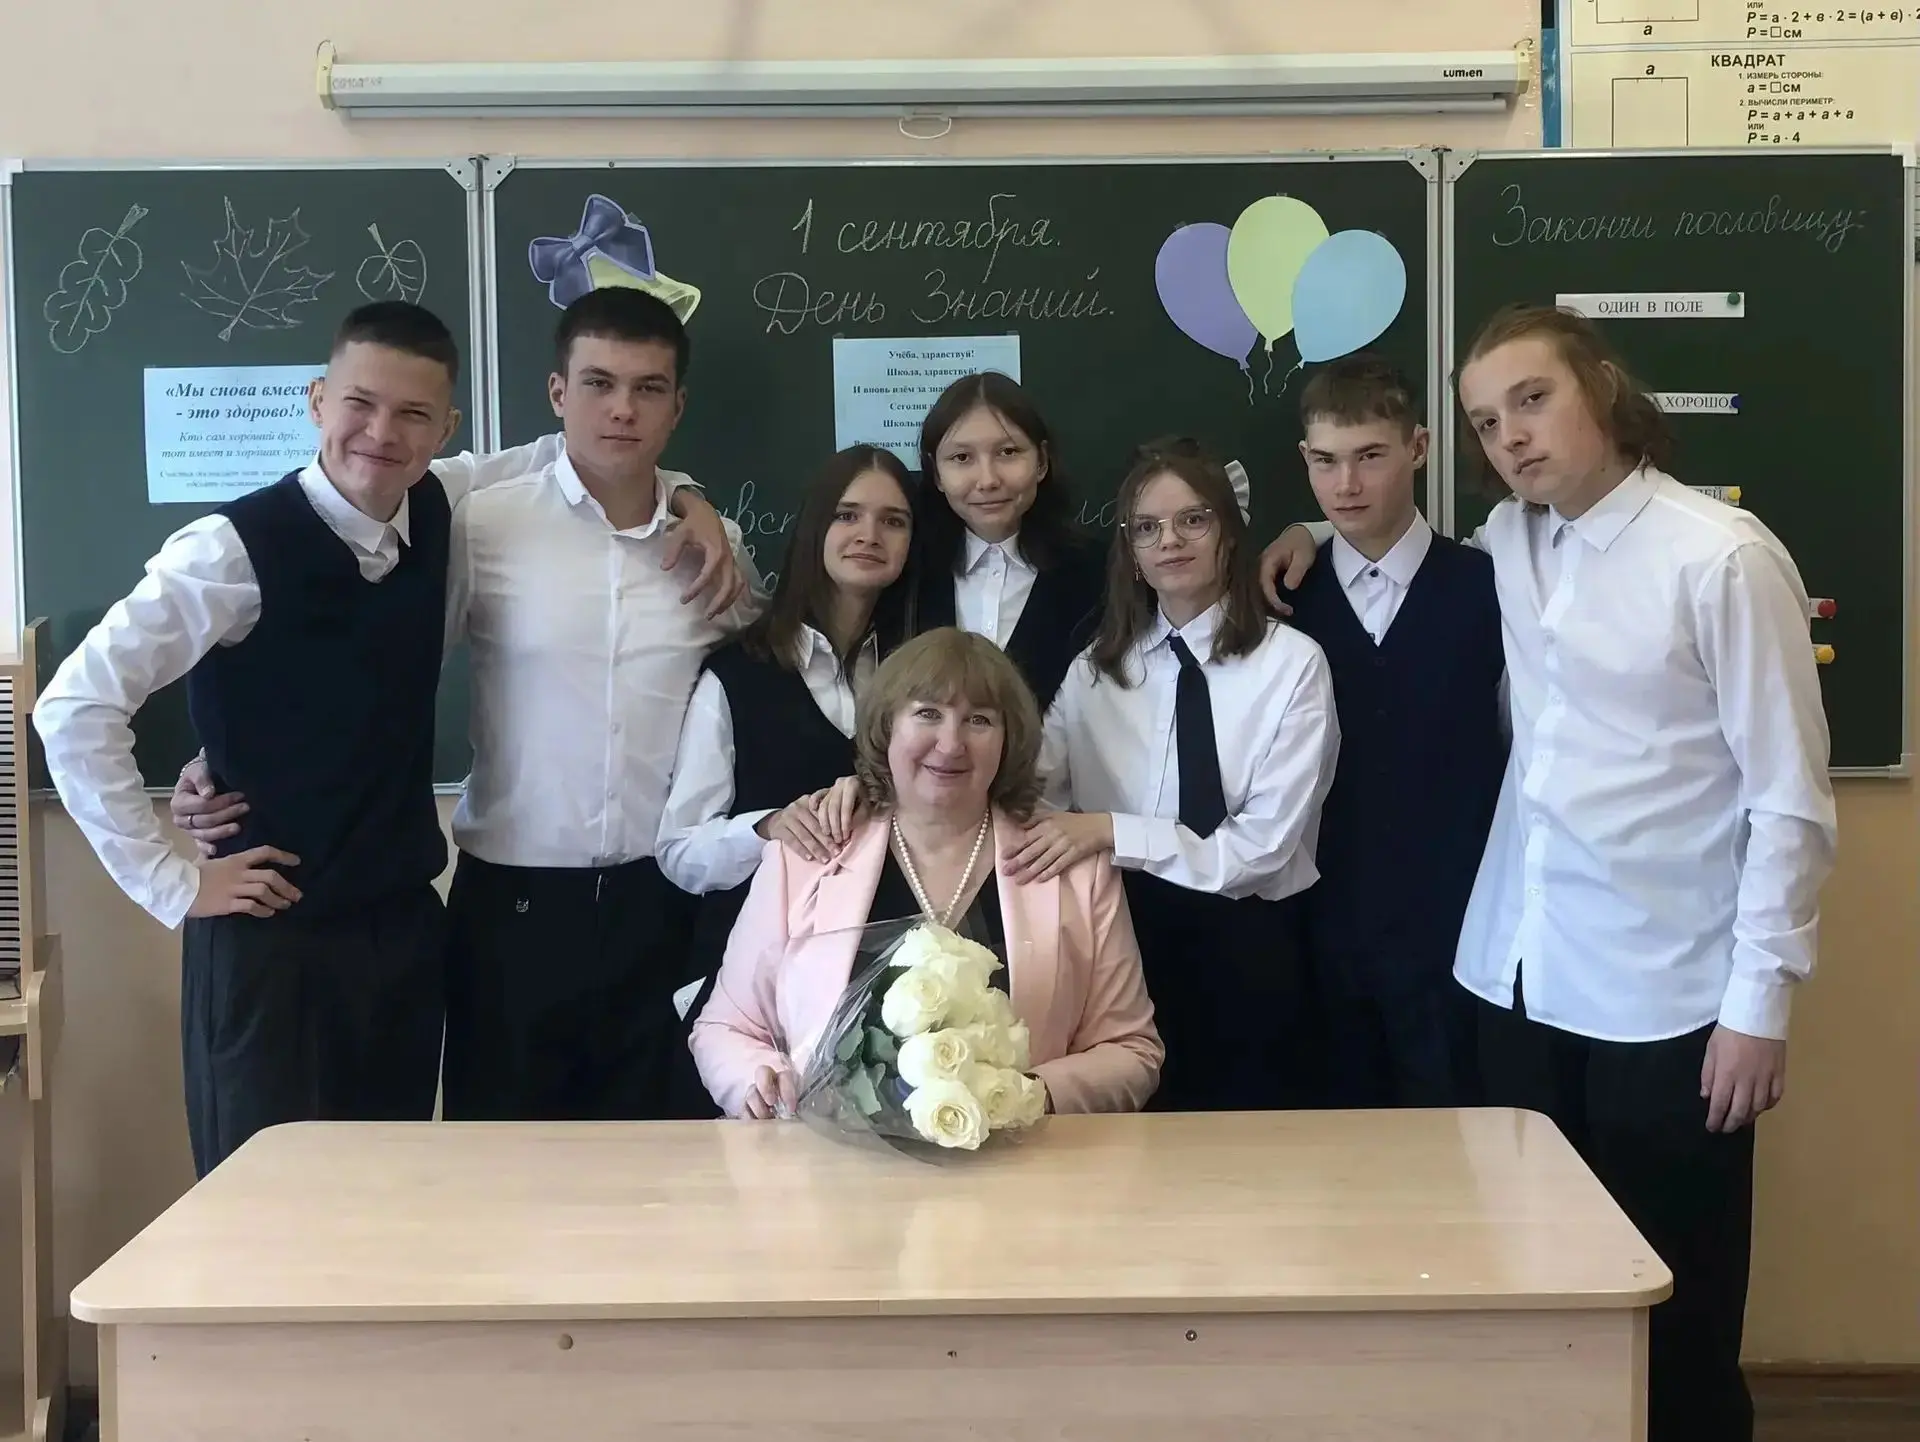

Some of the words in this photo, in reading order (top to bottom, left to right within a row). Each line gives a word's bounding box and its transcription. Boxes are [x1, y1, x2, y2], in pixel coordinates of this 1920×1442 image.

[1711, 54, 1786, 69] КВАДРАТ
[1746, 72, 1779, 80] ИЗМЕРЬ
[1781, 71, 1824, 79] СТОРОНЫ:
[1748, 99, 1788, 107] ВЫЧИСЛИ
[1789, 97, 1836, 106] ПЕРИМЕТР:
[1492, 183, 1656, 247] Закончи
[1674, 193, 1868, 254] пословицу:
[792, 198, 814, 254] 1
[837, 192, 1061, 284] сентября.
[752, 272, 887, 335] День
[911, 266, 1116, 324] Знаний.
[1598, 300, 1640, 315] ОДИН
[1647, 300, 1657, 313] В
[1664, 300, 1705, 313] ПОЛЕ
[888, 349, 919, 361] Учёба,
[921, 349, 975, 362] здравствуй!
[886, 367, 922, 378] Школа,
[165, 382, 205, 398] «Мы
[210, 385, 257, 397] снова
[853, 386, 861, 394] И
[187, 407, 220, 420] это
[225, 403, 305, 422] здорово!»
[889, 402, 927, 411] Сегодня
[179, 431, 203, 443] Кто
[161, 450, 186, 458] тот
